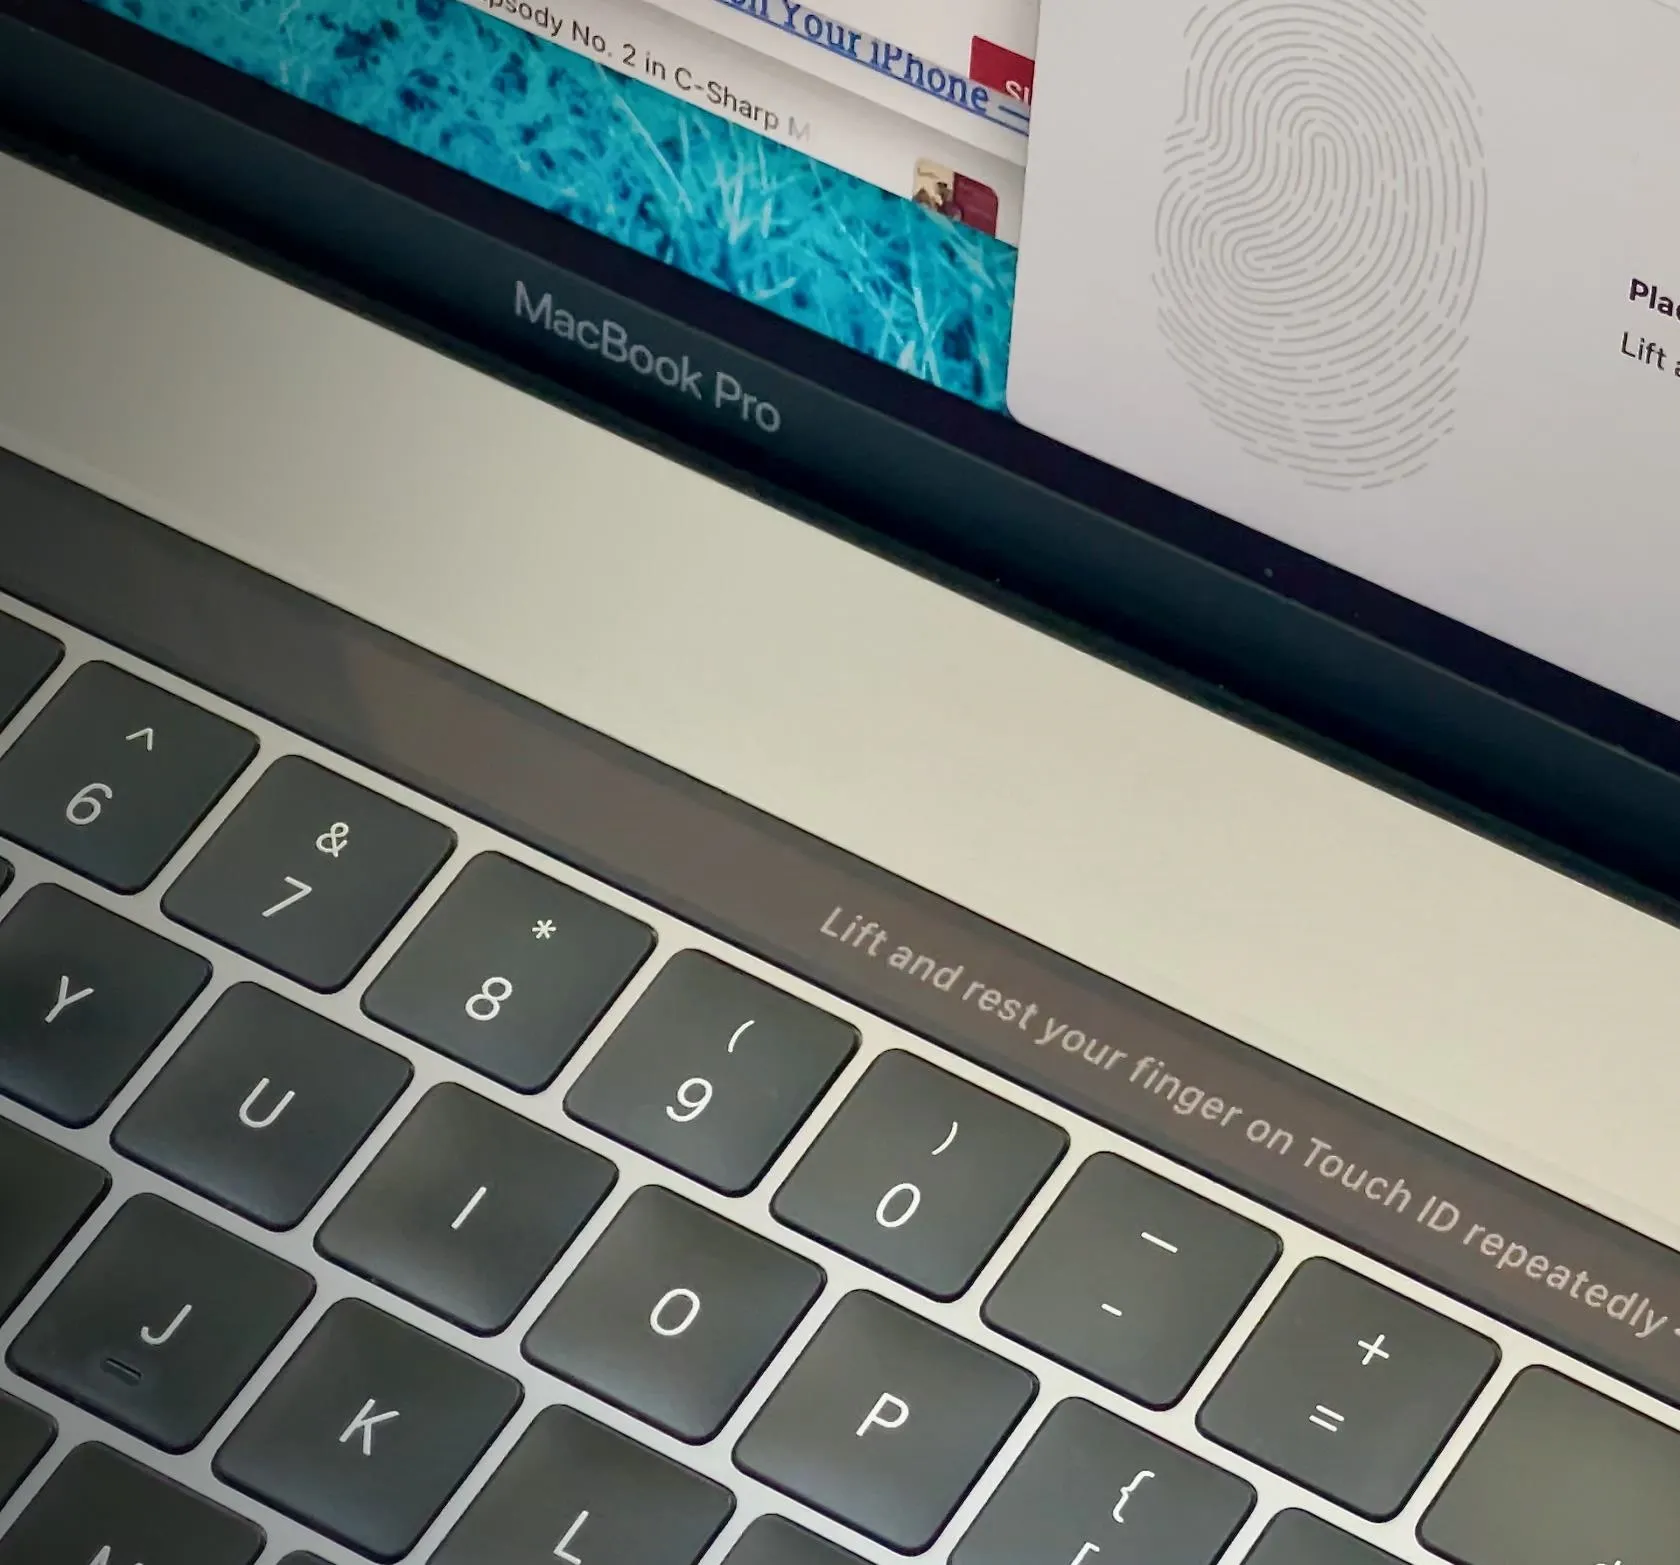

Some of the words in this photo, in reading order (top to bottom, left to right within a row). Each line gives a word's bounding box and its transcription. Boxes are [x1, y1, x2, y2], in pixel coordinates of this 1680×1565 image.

[571, 19, 612, 58] No.
[621, 43, 637, 67] 2
[645, 51, 667, 81] in
[674, 66, 779, 131] C-Sharp
[783, 0, 862, 58] Your
[870, 40, 989, 115] iPhone
[515, 279, 703, 400] MacBook
[715, 371, 781, 433] Pro
[1621, 331, 1667, 370] Lift
[66, 782, 113, 825] 6
[315, 822, 349, 858] &
[262, 876, 313, 917] 7
[45, 975, 94, 1023] Y
[465, 976, 513, 1021] 8
[727, 1019, 755, 1053] (
[239, 1077, 296, 1128] U
[666, 1077, 713, 1123] 9
[820, 906, 888, 957] Lift
[888, 945, 964, 992] and
[961, 980, 1039, 1031] rest
[1034, 1016, 1128, 1070] your
[1129, 1056, 1243, 1127] finger
[1246, 1119, 1294, 1155] on
[1303, 1137, 1412, 1213] Touch
[1416, 1195, 1460, 1232] ID
[1463, 1223, 1668, 1339] repeatedly
[931, 1121, 958, 1156] )
[451, 1186, 487, 1230] I
[140, 1304, 192, 1345] J
[650, 1288, 701, 1336] O
[339, 1398, 400, 1456] K
[855, 1392, 910, 1437] P
[553, 1510, 589, 1565] L
